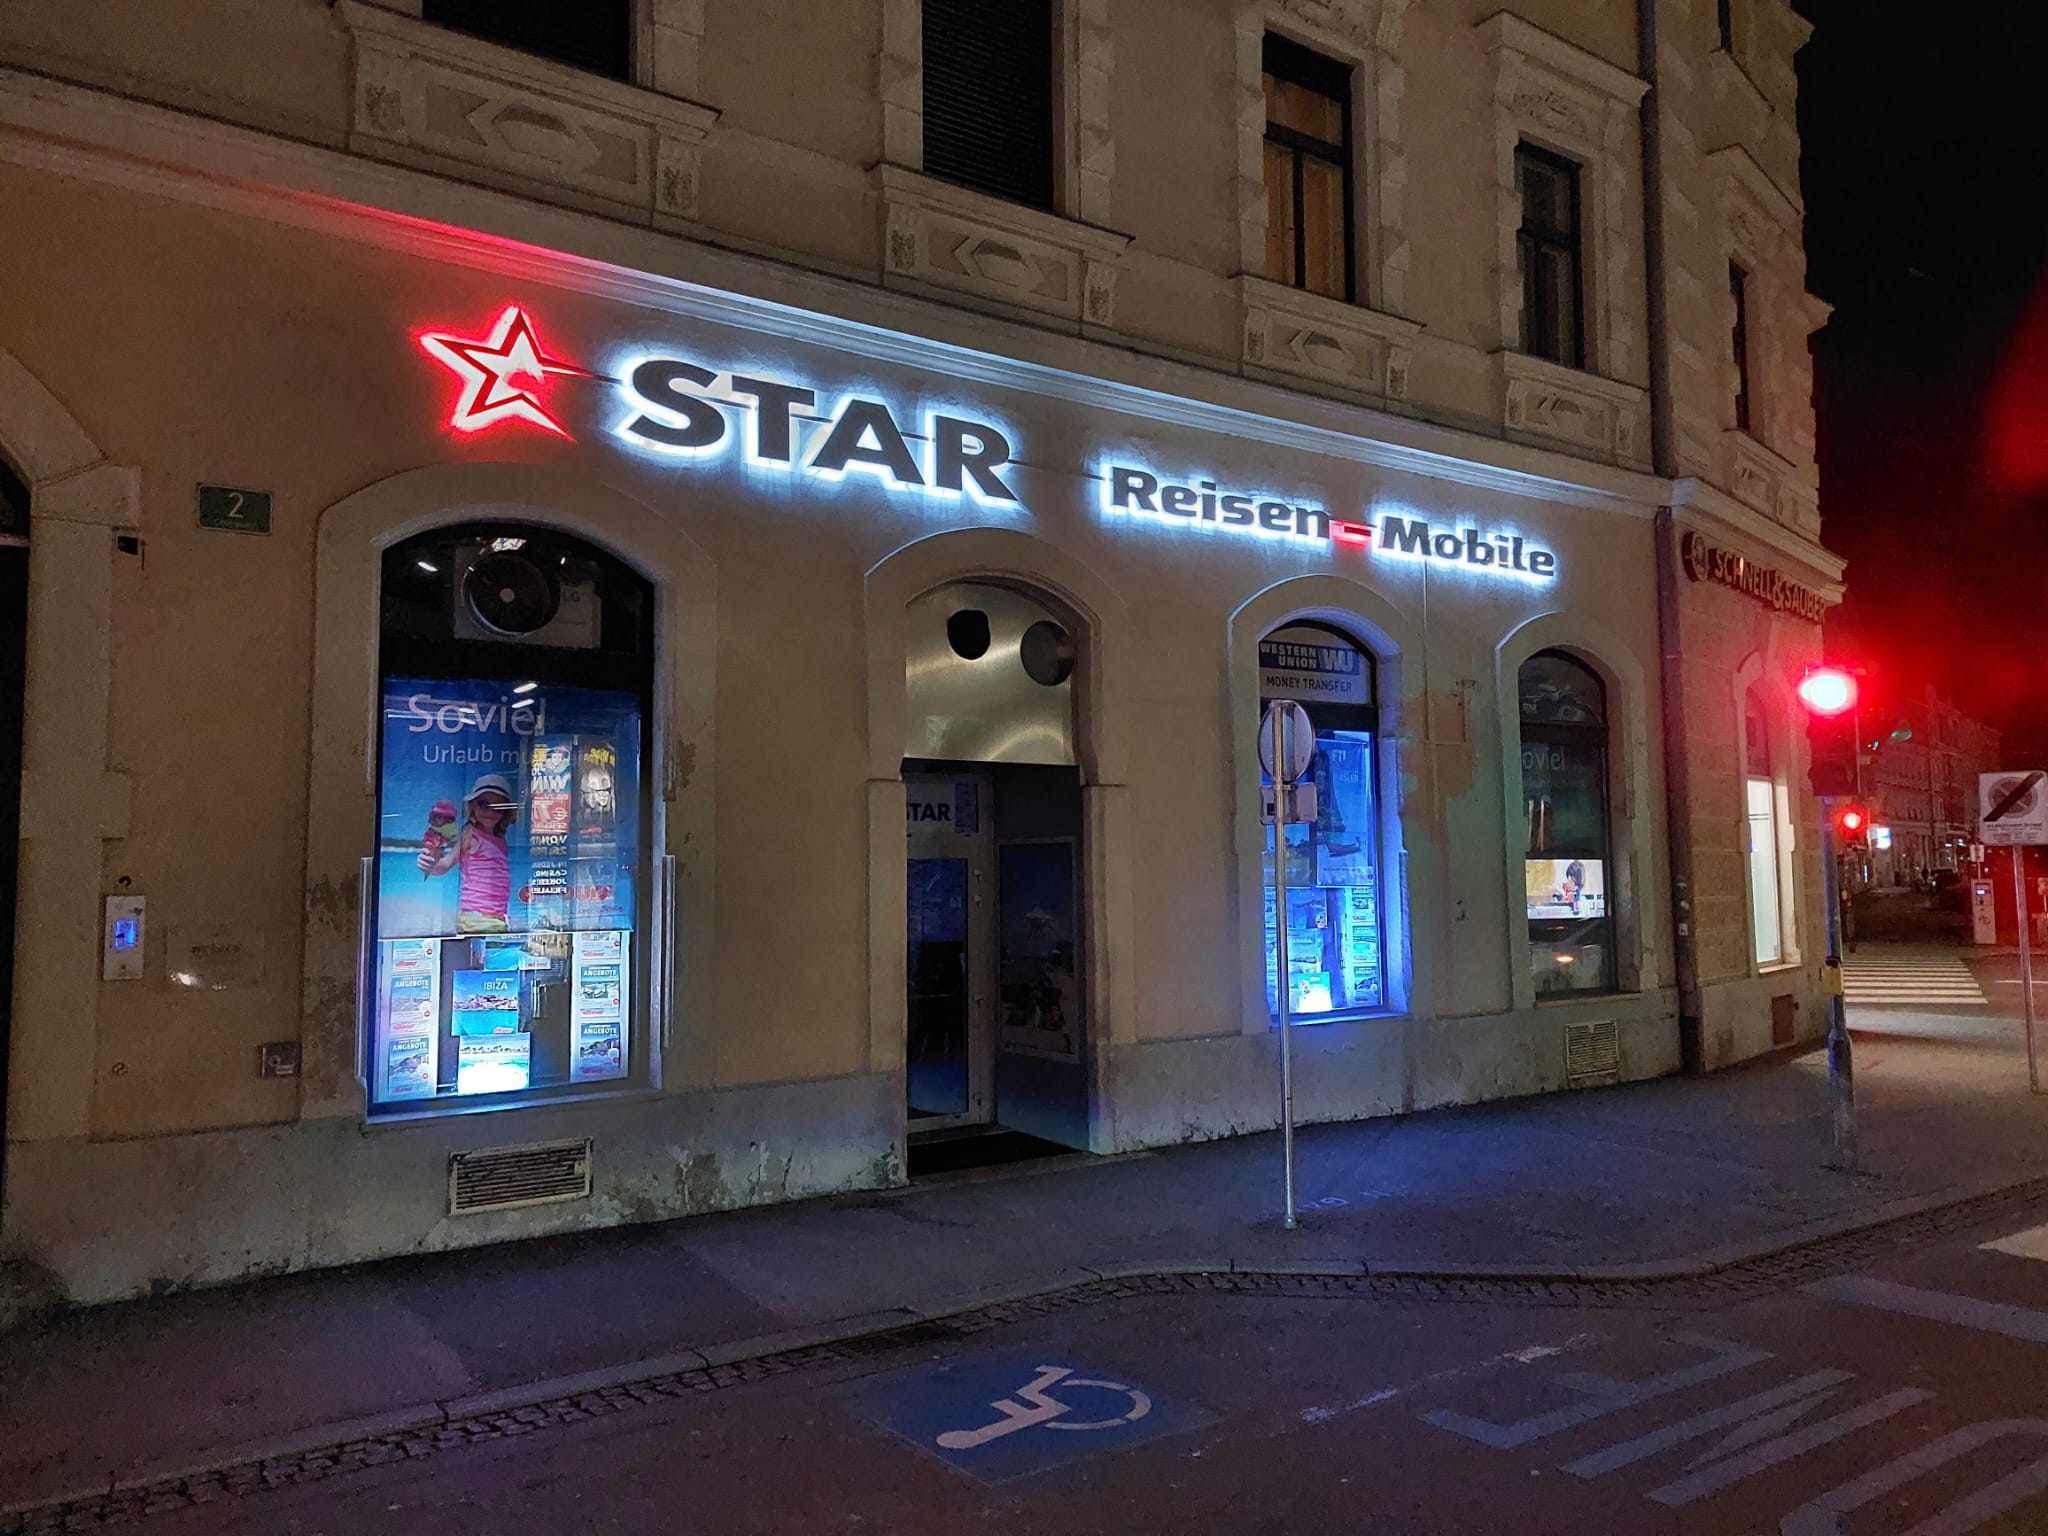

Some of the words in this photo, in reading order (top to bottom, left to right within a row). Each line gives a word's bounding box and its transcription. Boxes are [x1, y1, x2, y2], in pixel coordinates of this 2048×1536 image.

[624, 358, 1019, 501] STAR
[227, 492, 245, 518] 2
[1714, 550, 1772, 602] SCHNELL
[1772, 569, 1785, 611] &
[1784, 583, 1826, 624] SAUBER
[1259, 643, 1317, 658] WESTERN
[1323, 648, 1354, 672] WU
[1278, 655, 1318, 668] UNION
[1266, 676, 1300, 689] MONEY
[1303, 678, 1353, 692] TRANSFER
[408, 694, 545, 736] Soviel
[424, 744, 493, 764] Urlaub
[906, 803, 952, 822] TAR
[484, 981, 508, 991] IBIZA
